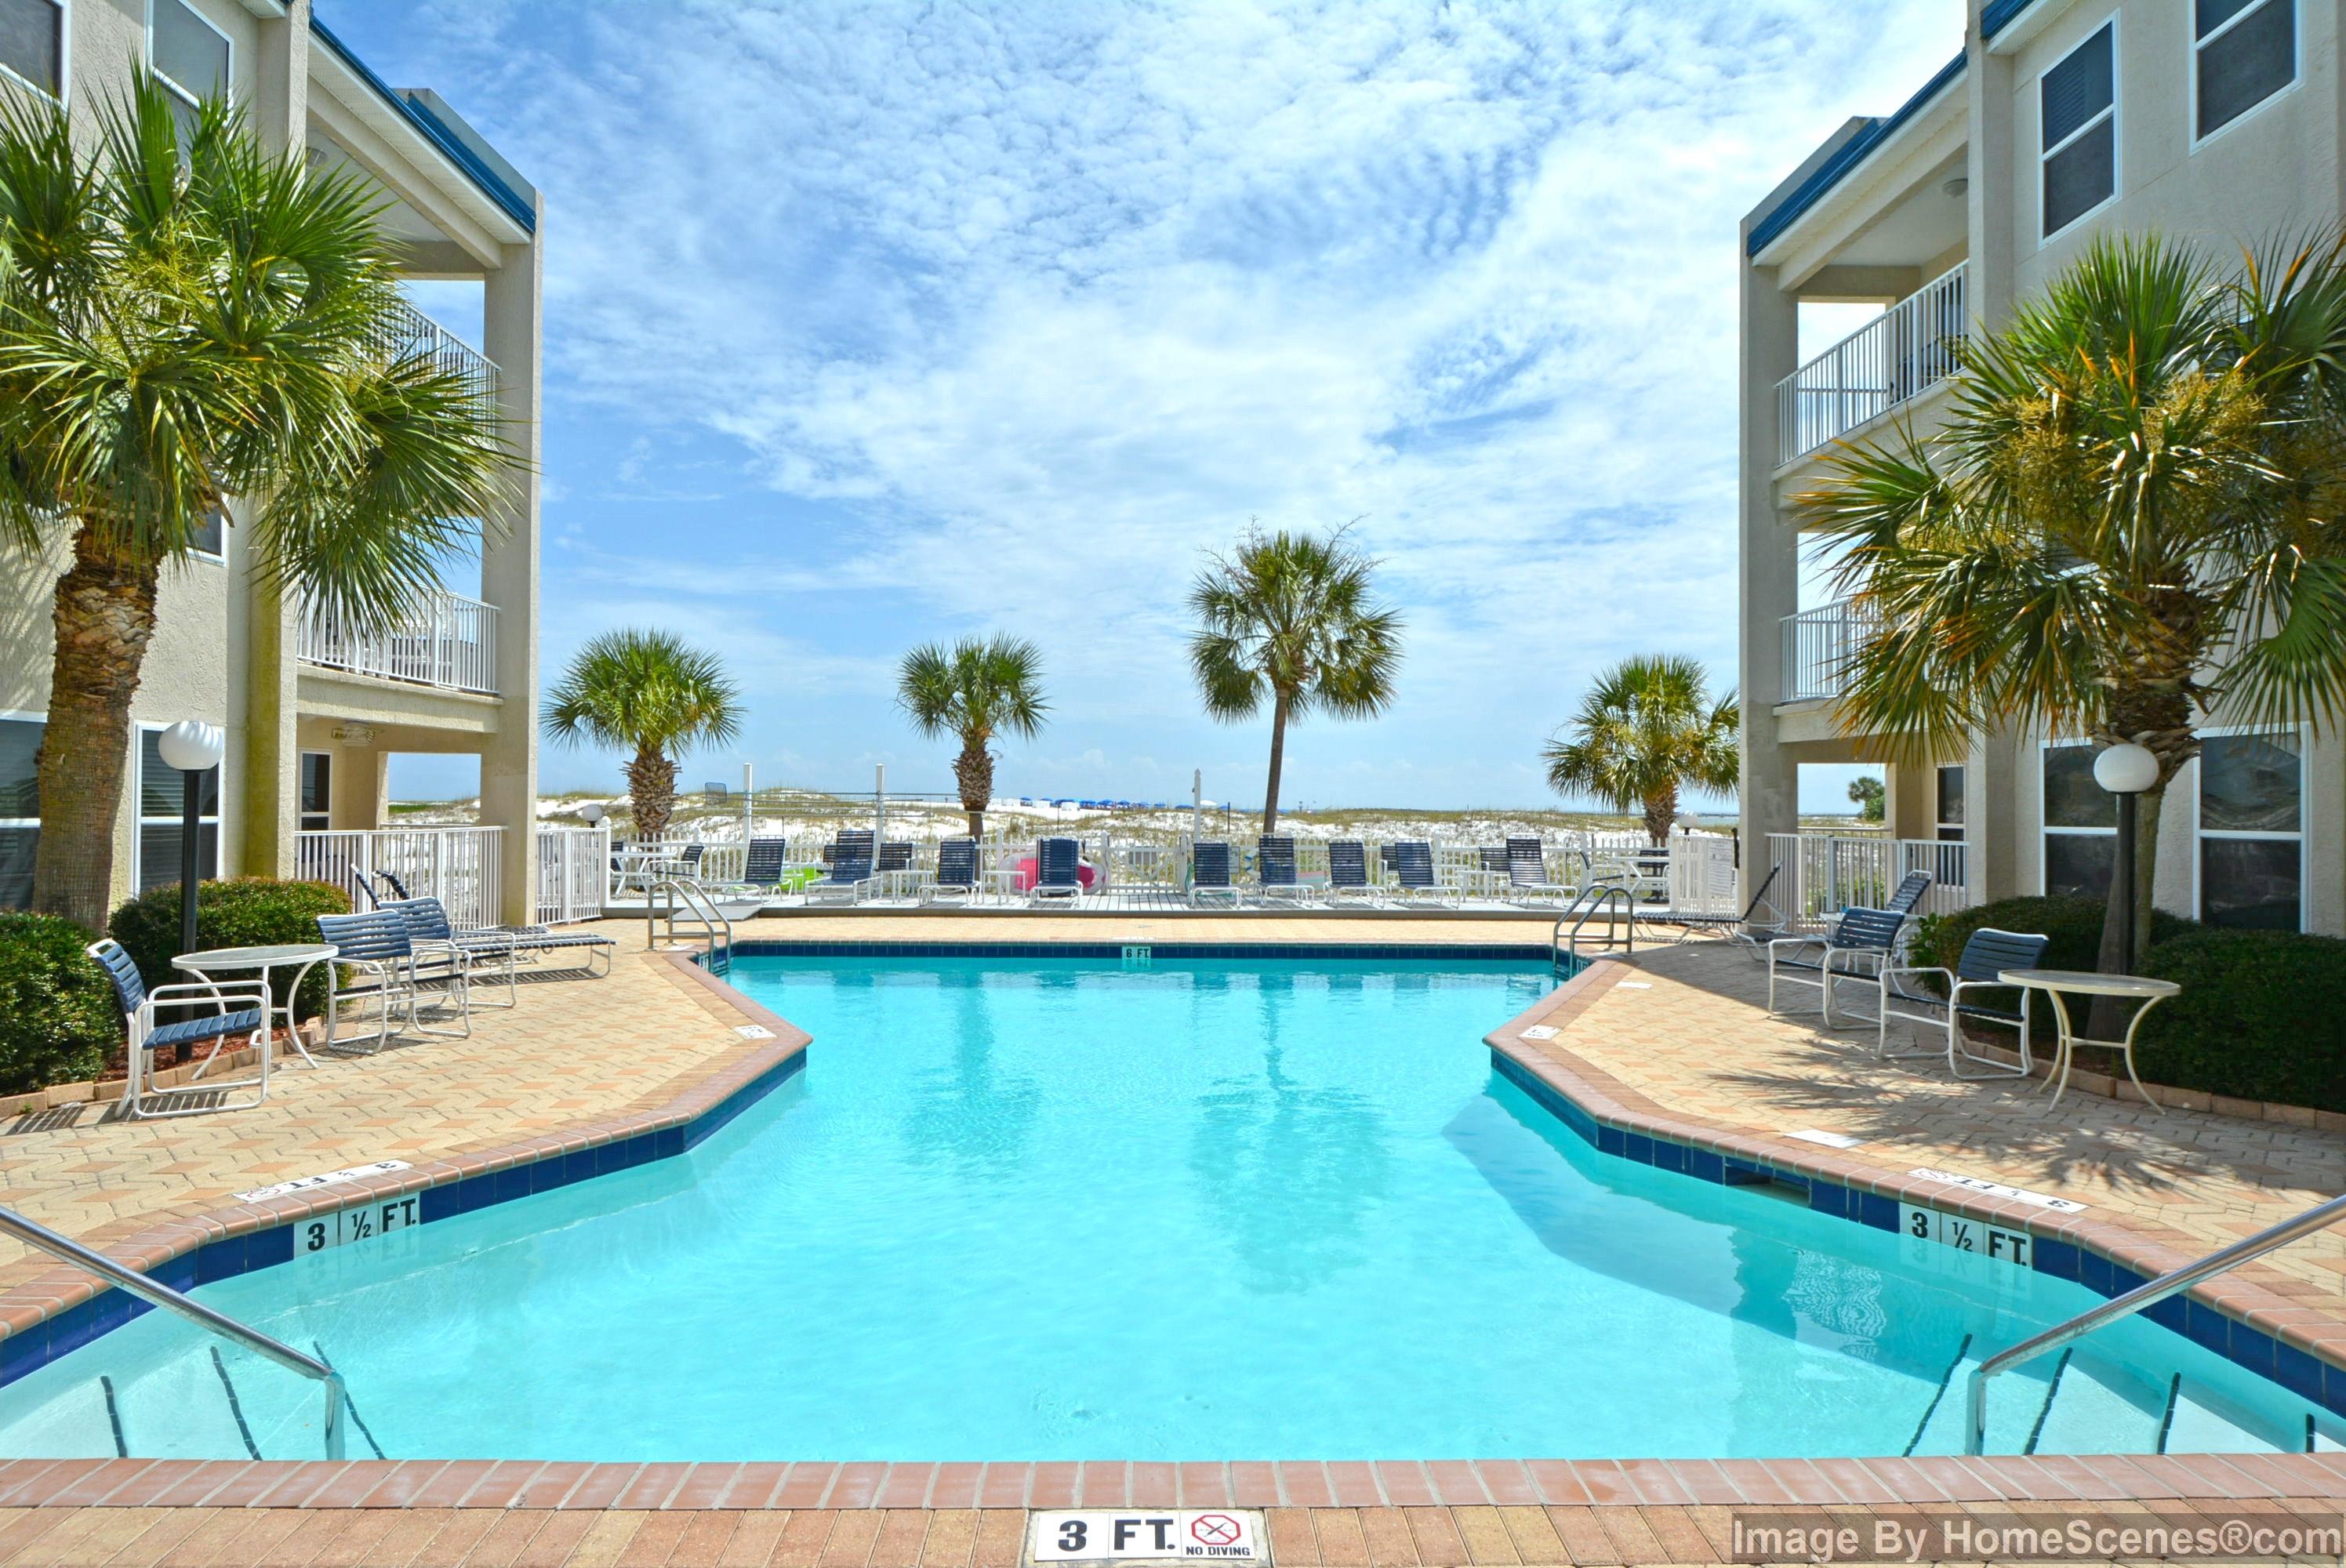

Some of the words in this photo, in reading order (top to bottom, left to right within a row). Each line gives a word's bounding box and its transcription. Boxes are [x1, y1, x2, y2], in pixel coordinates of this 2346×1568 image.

[1126, 948, 1132, 958] 6
[307, 1223, 325, 1251] 3
[383, 1198, 417, 1232] FT.
[1912, 1211, 1928, 1239] 3
[1988, 1230, 2028, 1266] FT.
[1058, 1520, 1088, 1552] 3
[1114, 1519, 1176, 1550] FT.
[1186, 1546, 1203, 1555] NO
[1208, 1547, 1251, 1555] DIVING
